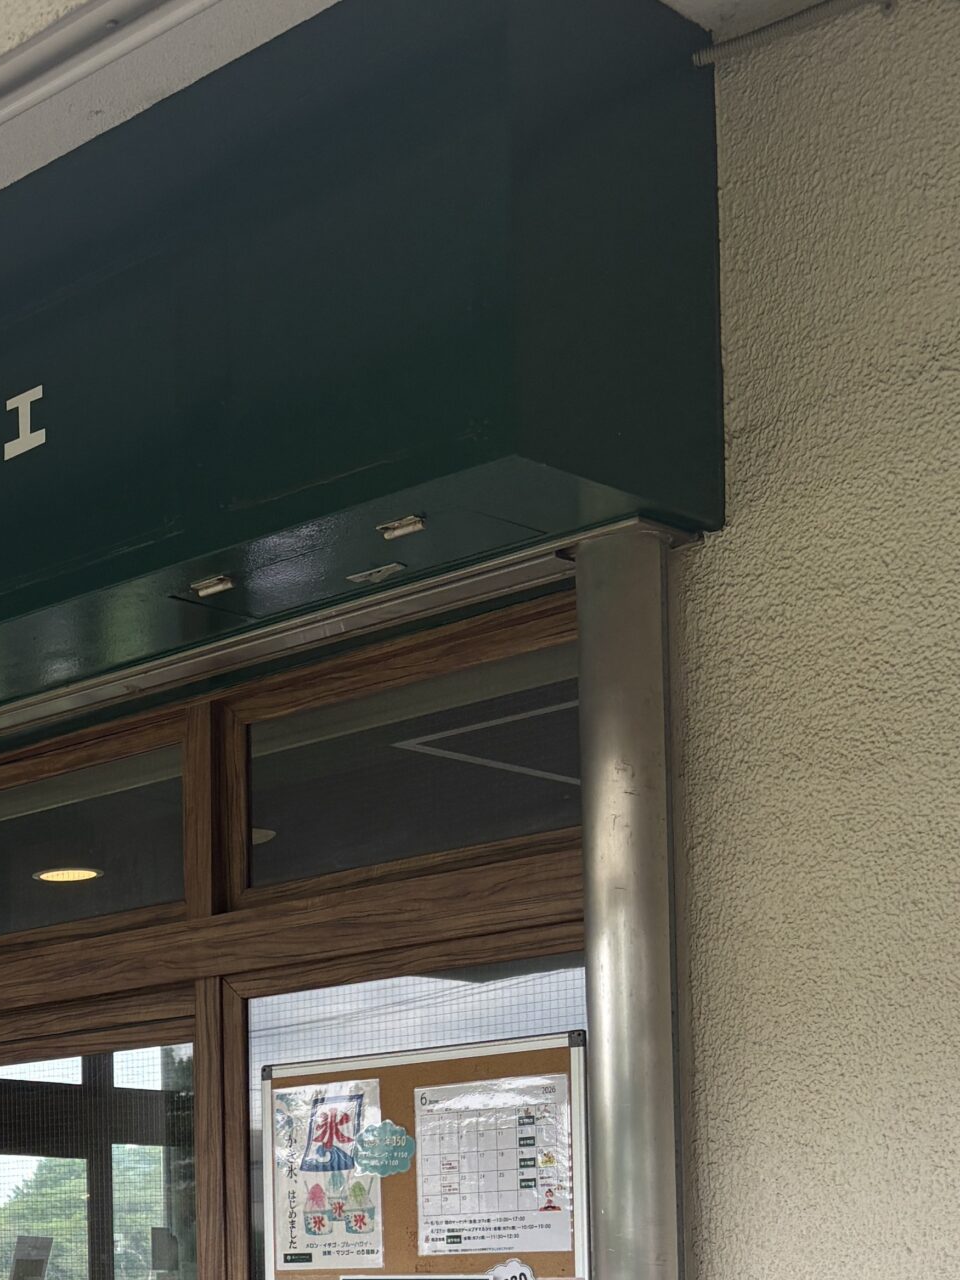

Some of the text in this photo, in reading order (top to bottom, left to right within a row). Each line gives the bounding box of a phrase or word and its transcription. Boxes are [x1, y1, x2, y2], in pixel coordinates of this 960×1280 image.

[420, 1093, 428, 1106] 6
[312, 1107, 355, 1150] 氷
[311, 1214, 325, 1232] 氷
[353, 1213, 367, 1230] 氷
